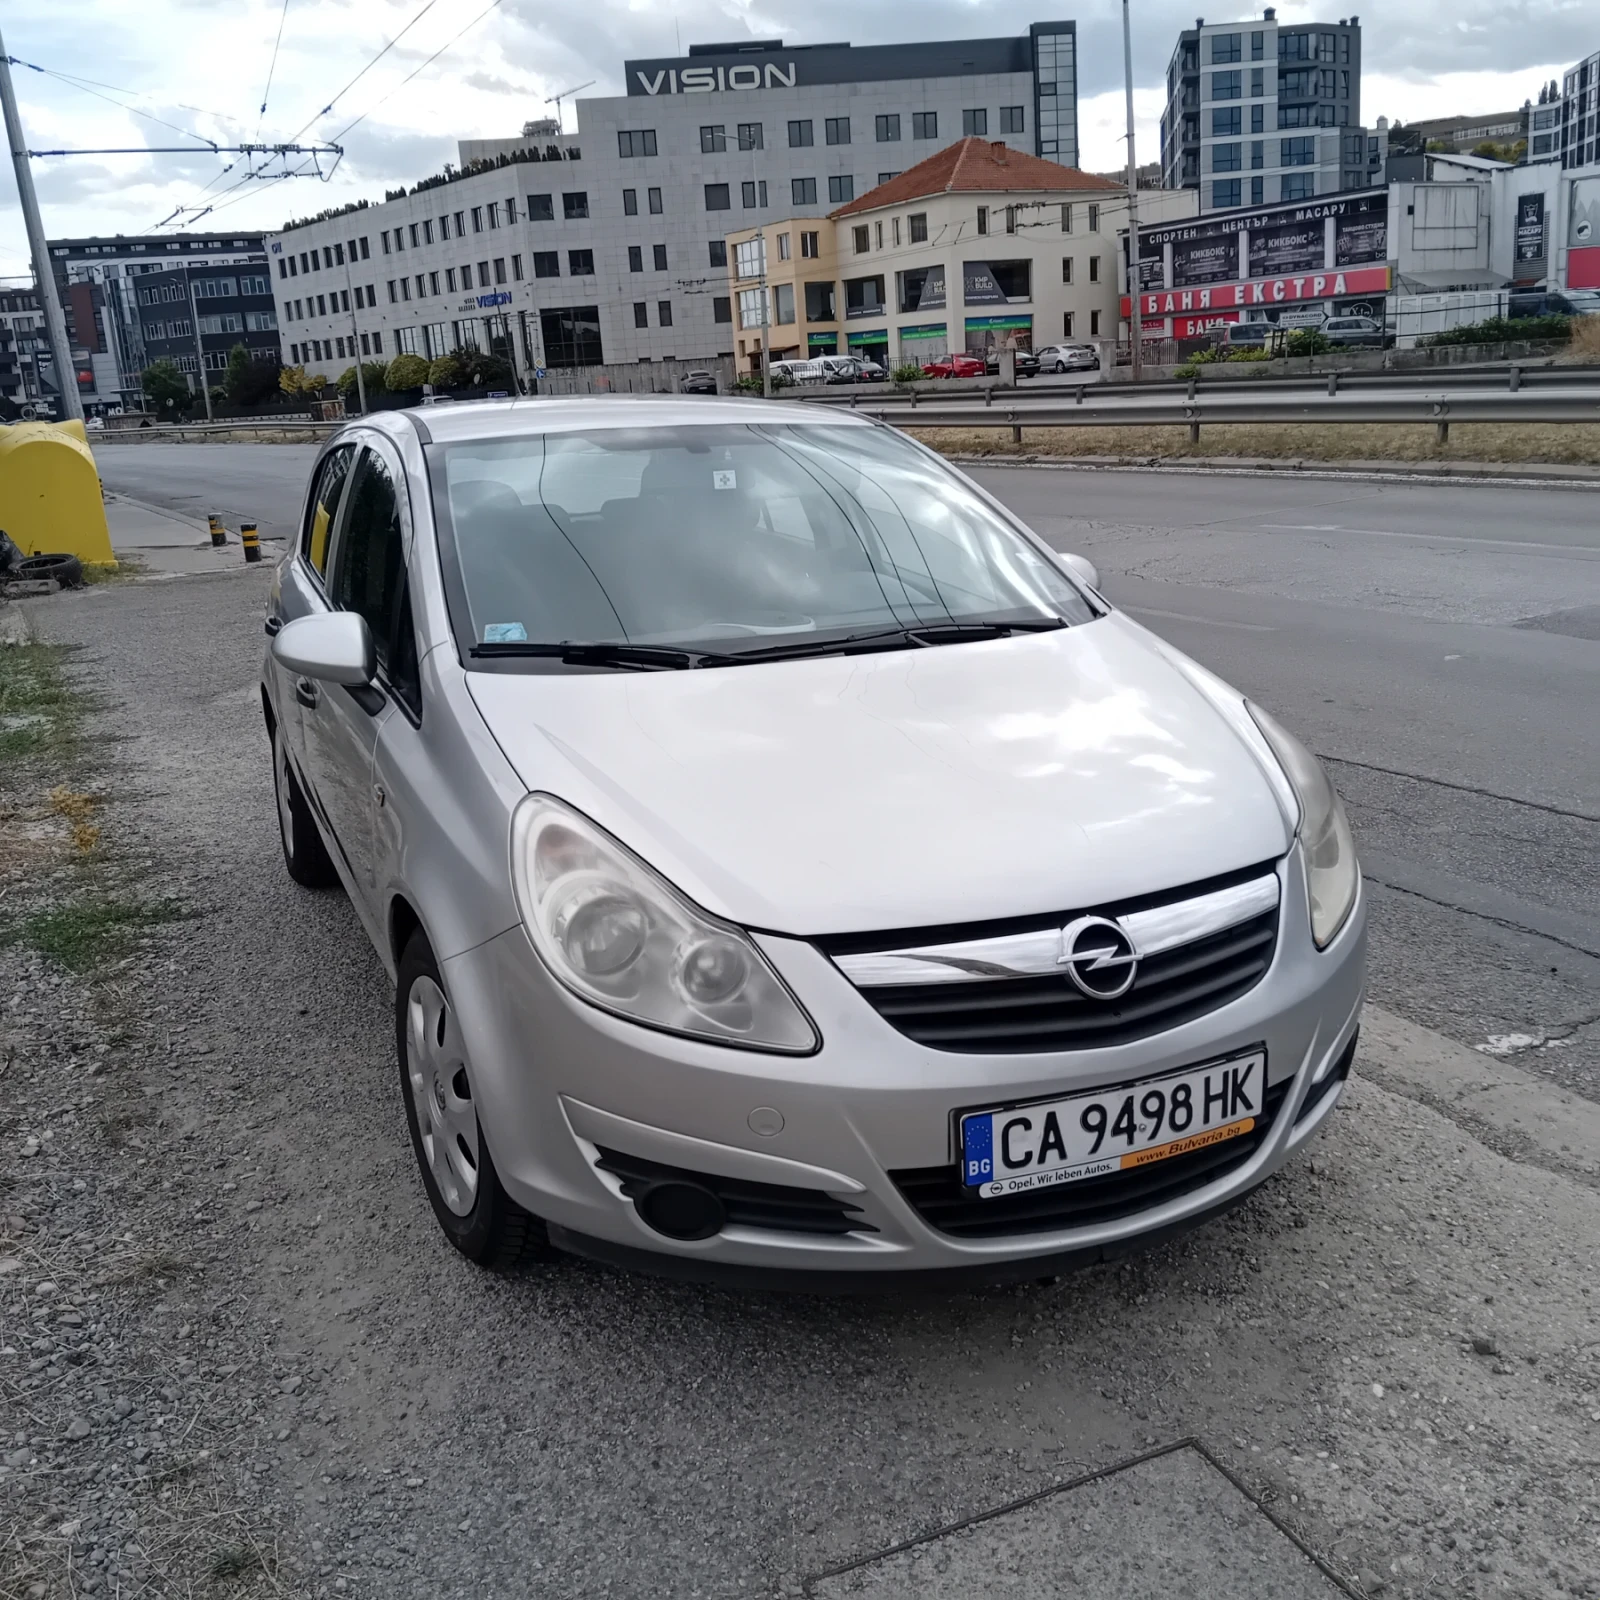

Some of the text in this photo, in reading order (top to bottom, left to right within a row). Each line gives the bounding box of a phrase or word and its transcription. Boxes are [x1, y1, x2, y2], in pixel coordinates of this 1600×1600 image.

[636, 62, 797, 96] VISION
[1149, 203, 1346, 244] СПОРТЕН ЦЕНТЪР МАСАРУ
[1190, 246, 1225, 260] КИКБОКС
[1268, 234, 1308, 248] КИКБОКС
[476, 291, 513, 309] VISION
[1148, 289, 1211, 313] БАНЯ
[1235, 274, 1347, 305] ЕКСТРА
[1002, 1062, 1255, 1169] CA 9498 HK
[969, 1159, 991, 1177] BG
[1008, 1163, 1113, 1191] Opel. Wir leben Autos.
